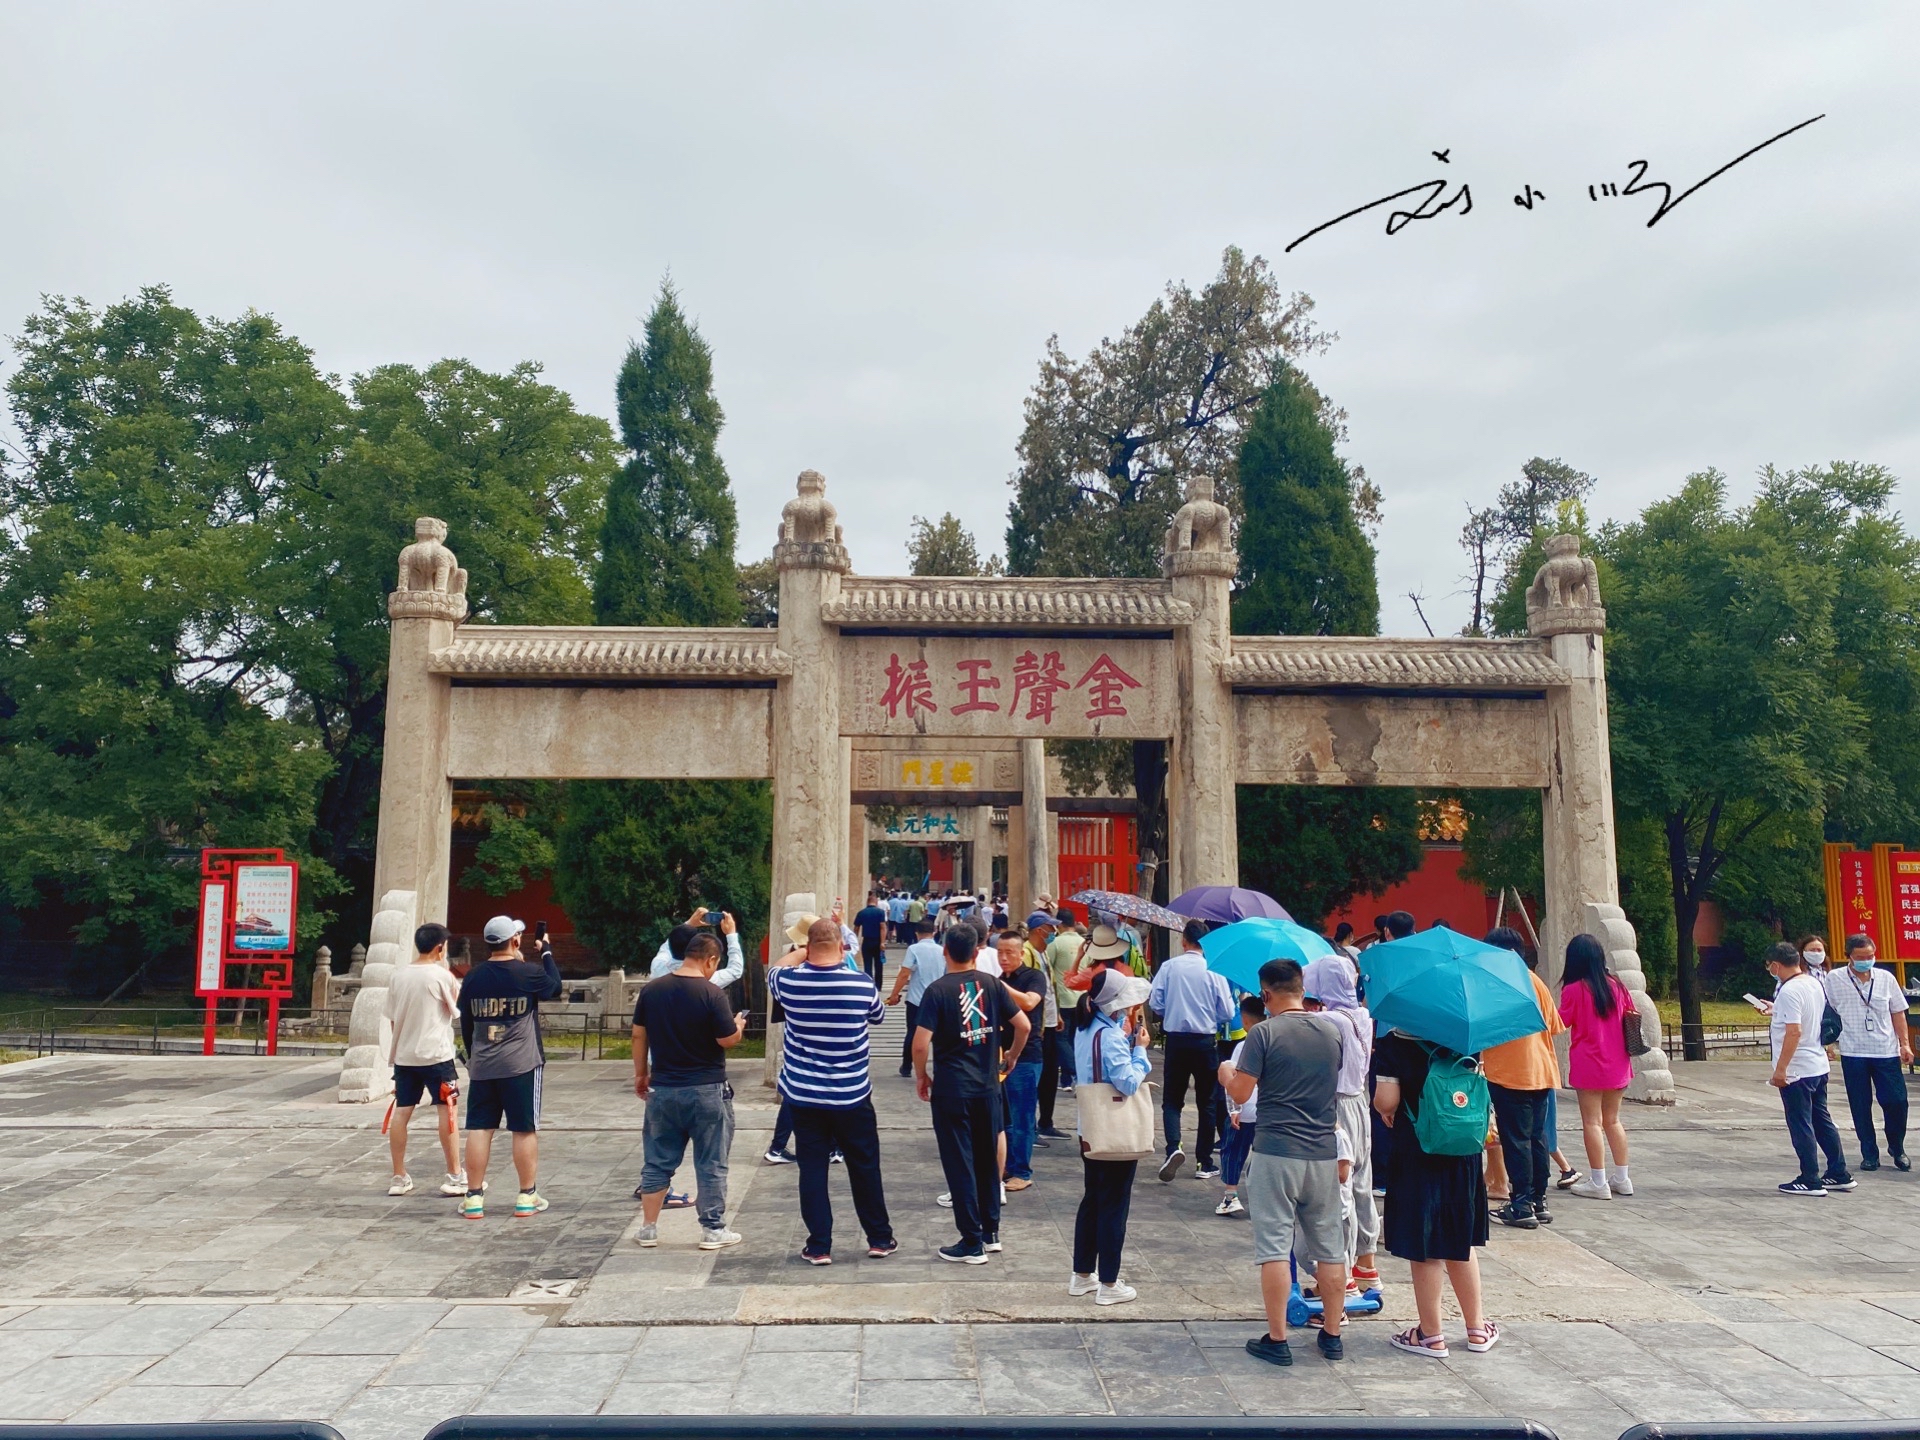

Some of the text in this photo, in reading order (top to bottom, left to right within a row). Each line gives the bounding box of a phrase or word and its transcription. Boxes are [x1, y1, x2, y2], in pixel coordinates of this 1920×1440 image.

[1900, 884, 1920, 894] 富强
[1852, 861, 1872, 936] 社会主义核心价
[1901, 899, 1920, 909] 民主
[471, 996, 527, 1016] UNDFTD
